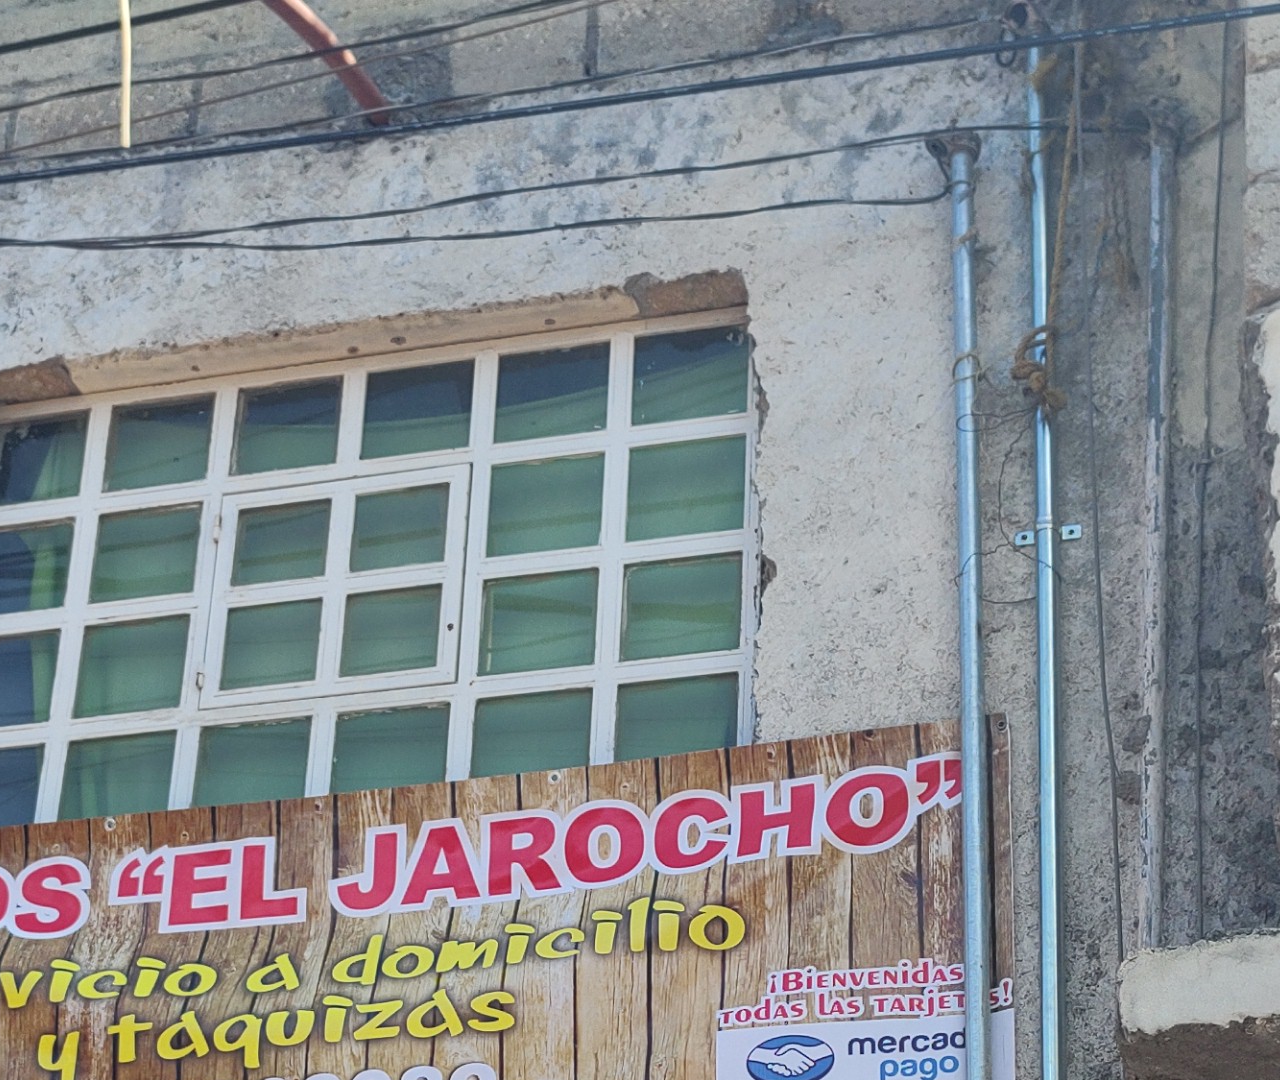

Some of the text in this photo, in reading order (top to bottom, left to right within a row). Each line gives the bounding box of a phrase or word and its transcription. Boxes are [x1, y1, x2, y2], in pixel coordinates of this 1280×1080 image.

[245, 953, 302, 993] a
[330, 896, 747, 985] domicilio
[106, 988, 517, 1070] taquizas
[848, 1026, 966, 1056] mercad
